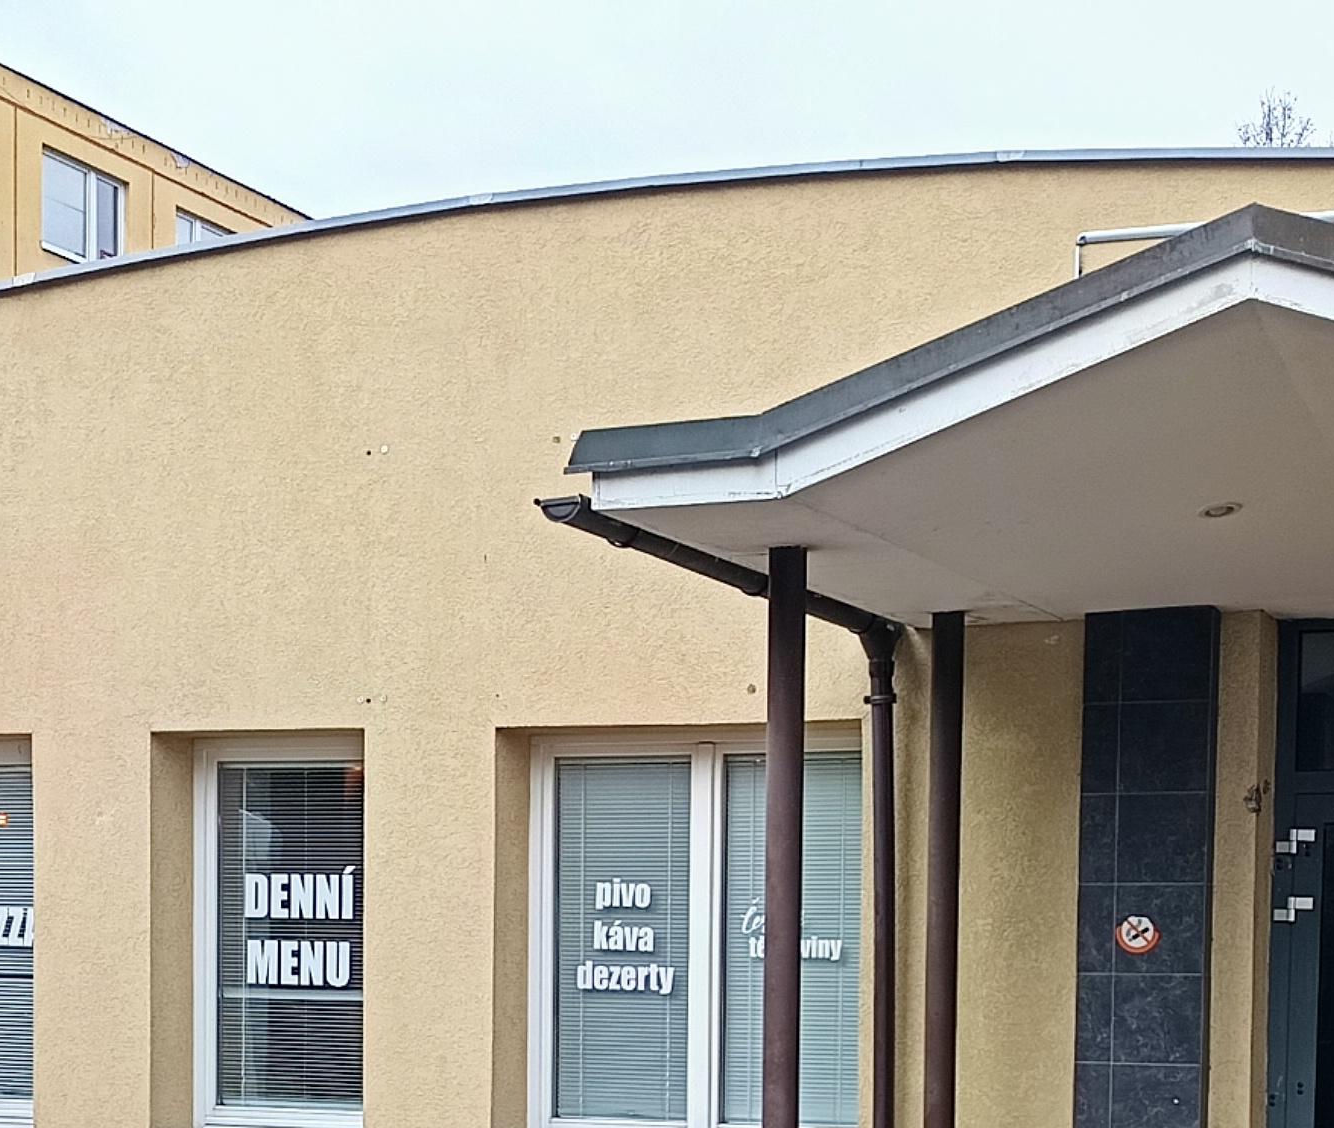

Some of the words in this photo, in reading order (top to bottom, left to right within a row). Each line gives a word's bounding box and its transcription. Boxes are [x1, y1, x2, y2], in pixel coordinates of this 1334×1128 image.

[244, 865, 356, 919] DENNÍ
[595, 878, 651, 910] pivo
[593, 920, 654, 952] káva
[247, 940, 350, 987] MENU
[577, 960, 675, 995] dezerty
